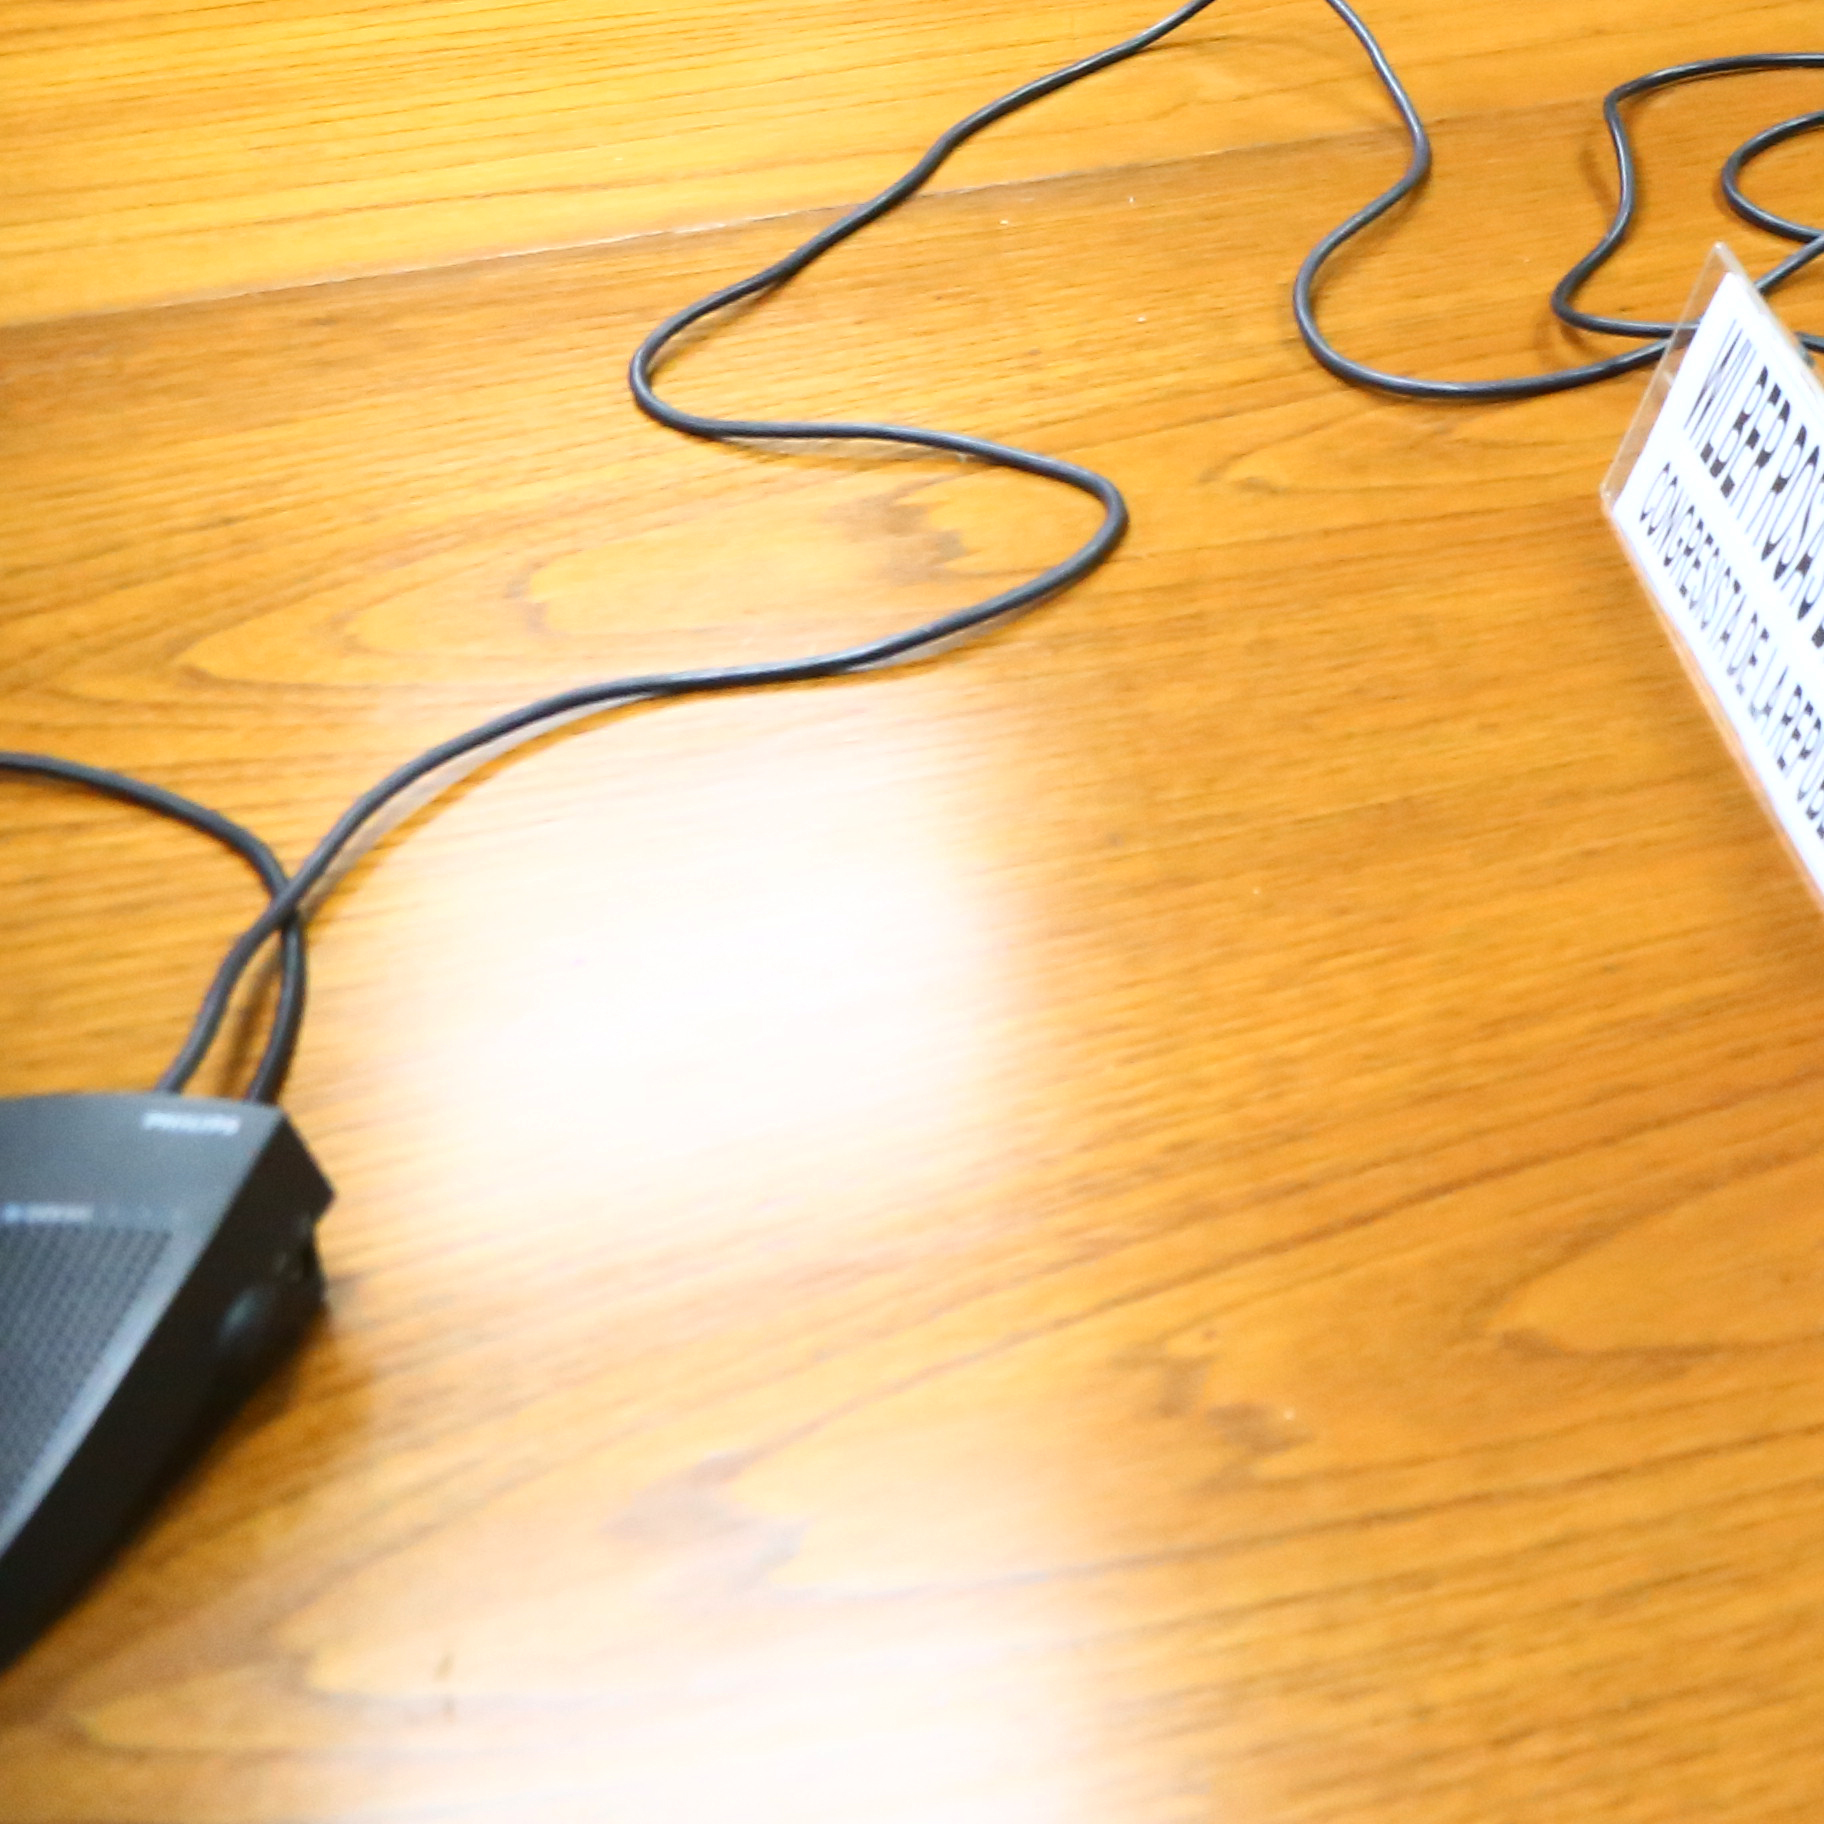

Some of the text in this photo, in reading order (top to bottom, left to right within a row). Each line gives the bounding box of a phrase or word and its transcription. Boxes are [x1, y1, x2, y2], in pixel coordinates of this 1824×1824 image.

[1681, 317, 1795, 523] WILBER
[1636, 457, 1749, 663] CONGRESISTA
[1724, 609, 1771, 700] DE
[1746, 646, 1792, 737] LA
